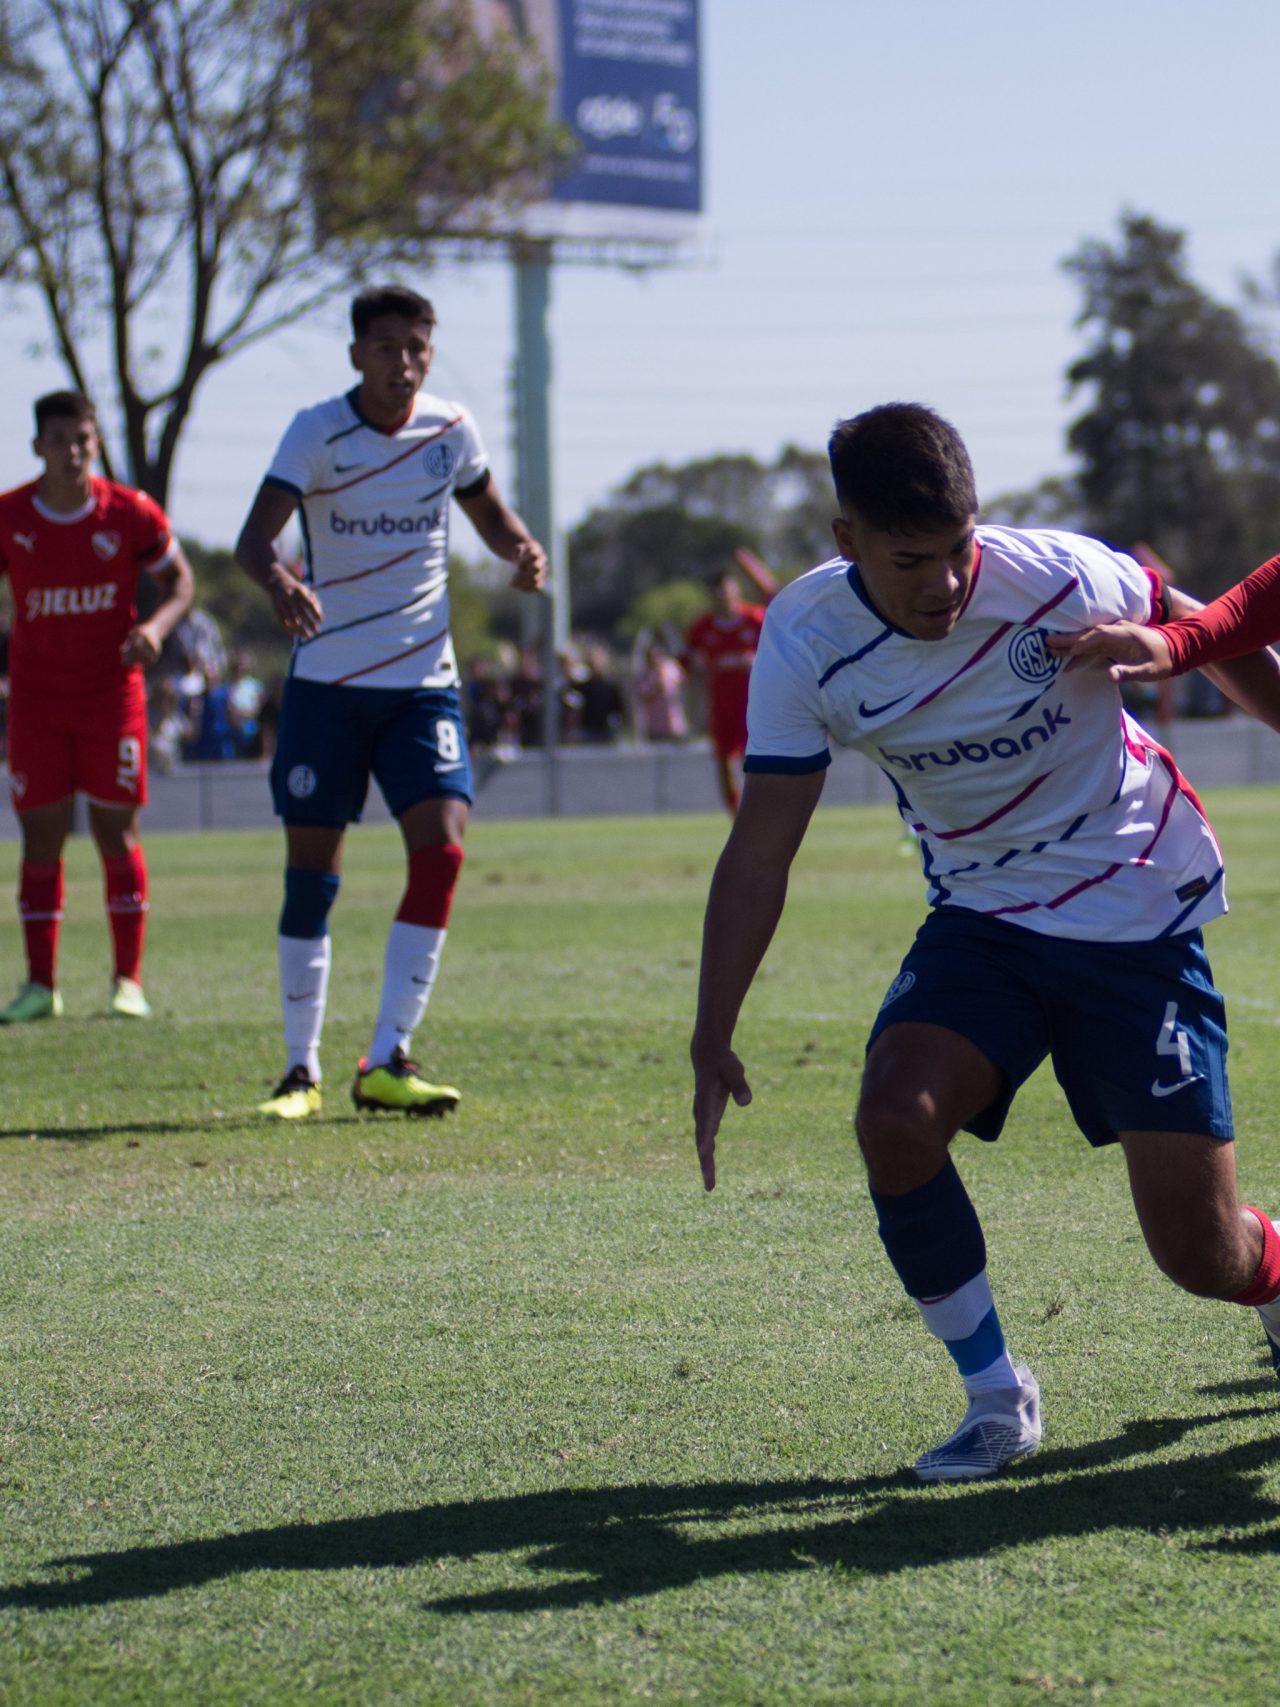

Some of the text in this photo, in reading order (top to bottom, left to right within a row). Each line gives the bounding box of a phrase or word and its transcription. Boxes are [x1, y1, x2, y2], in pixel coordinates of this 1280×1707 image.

[41, 582, 118, 617] JELUZ
[117, 736, 140, 777] 9
[435, 718, 461, 762] 8
[878, 702, 1073, 773] brubank
[1155, 1000, 1193, 1076] 4
